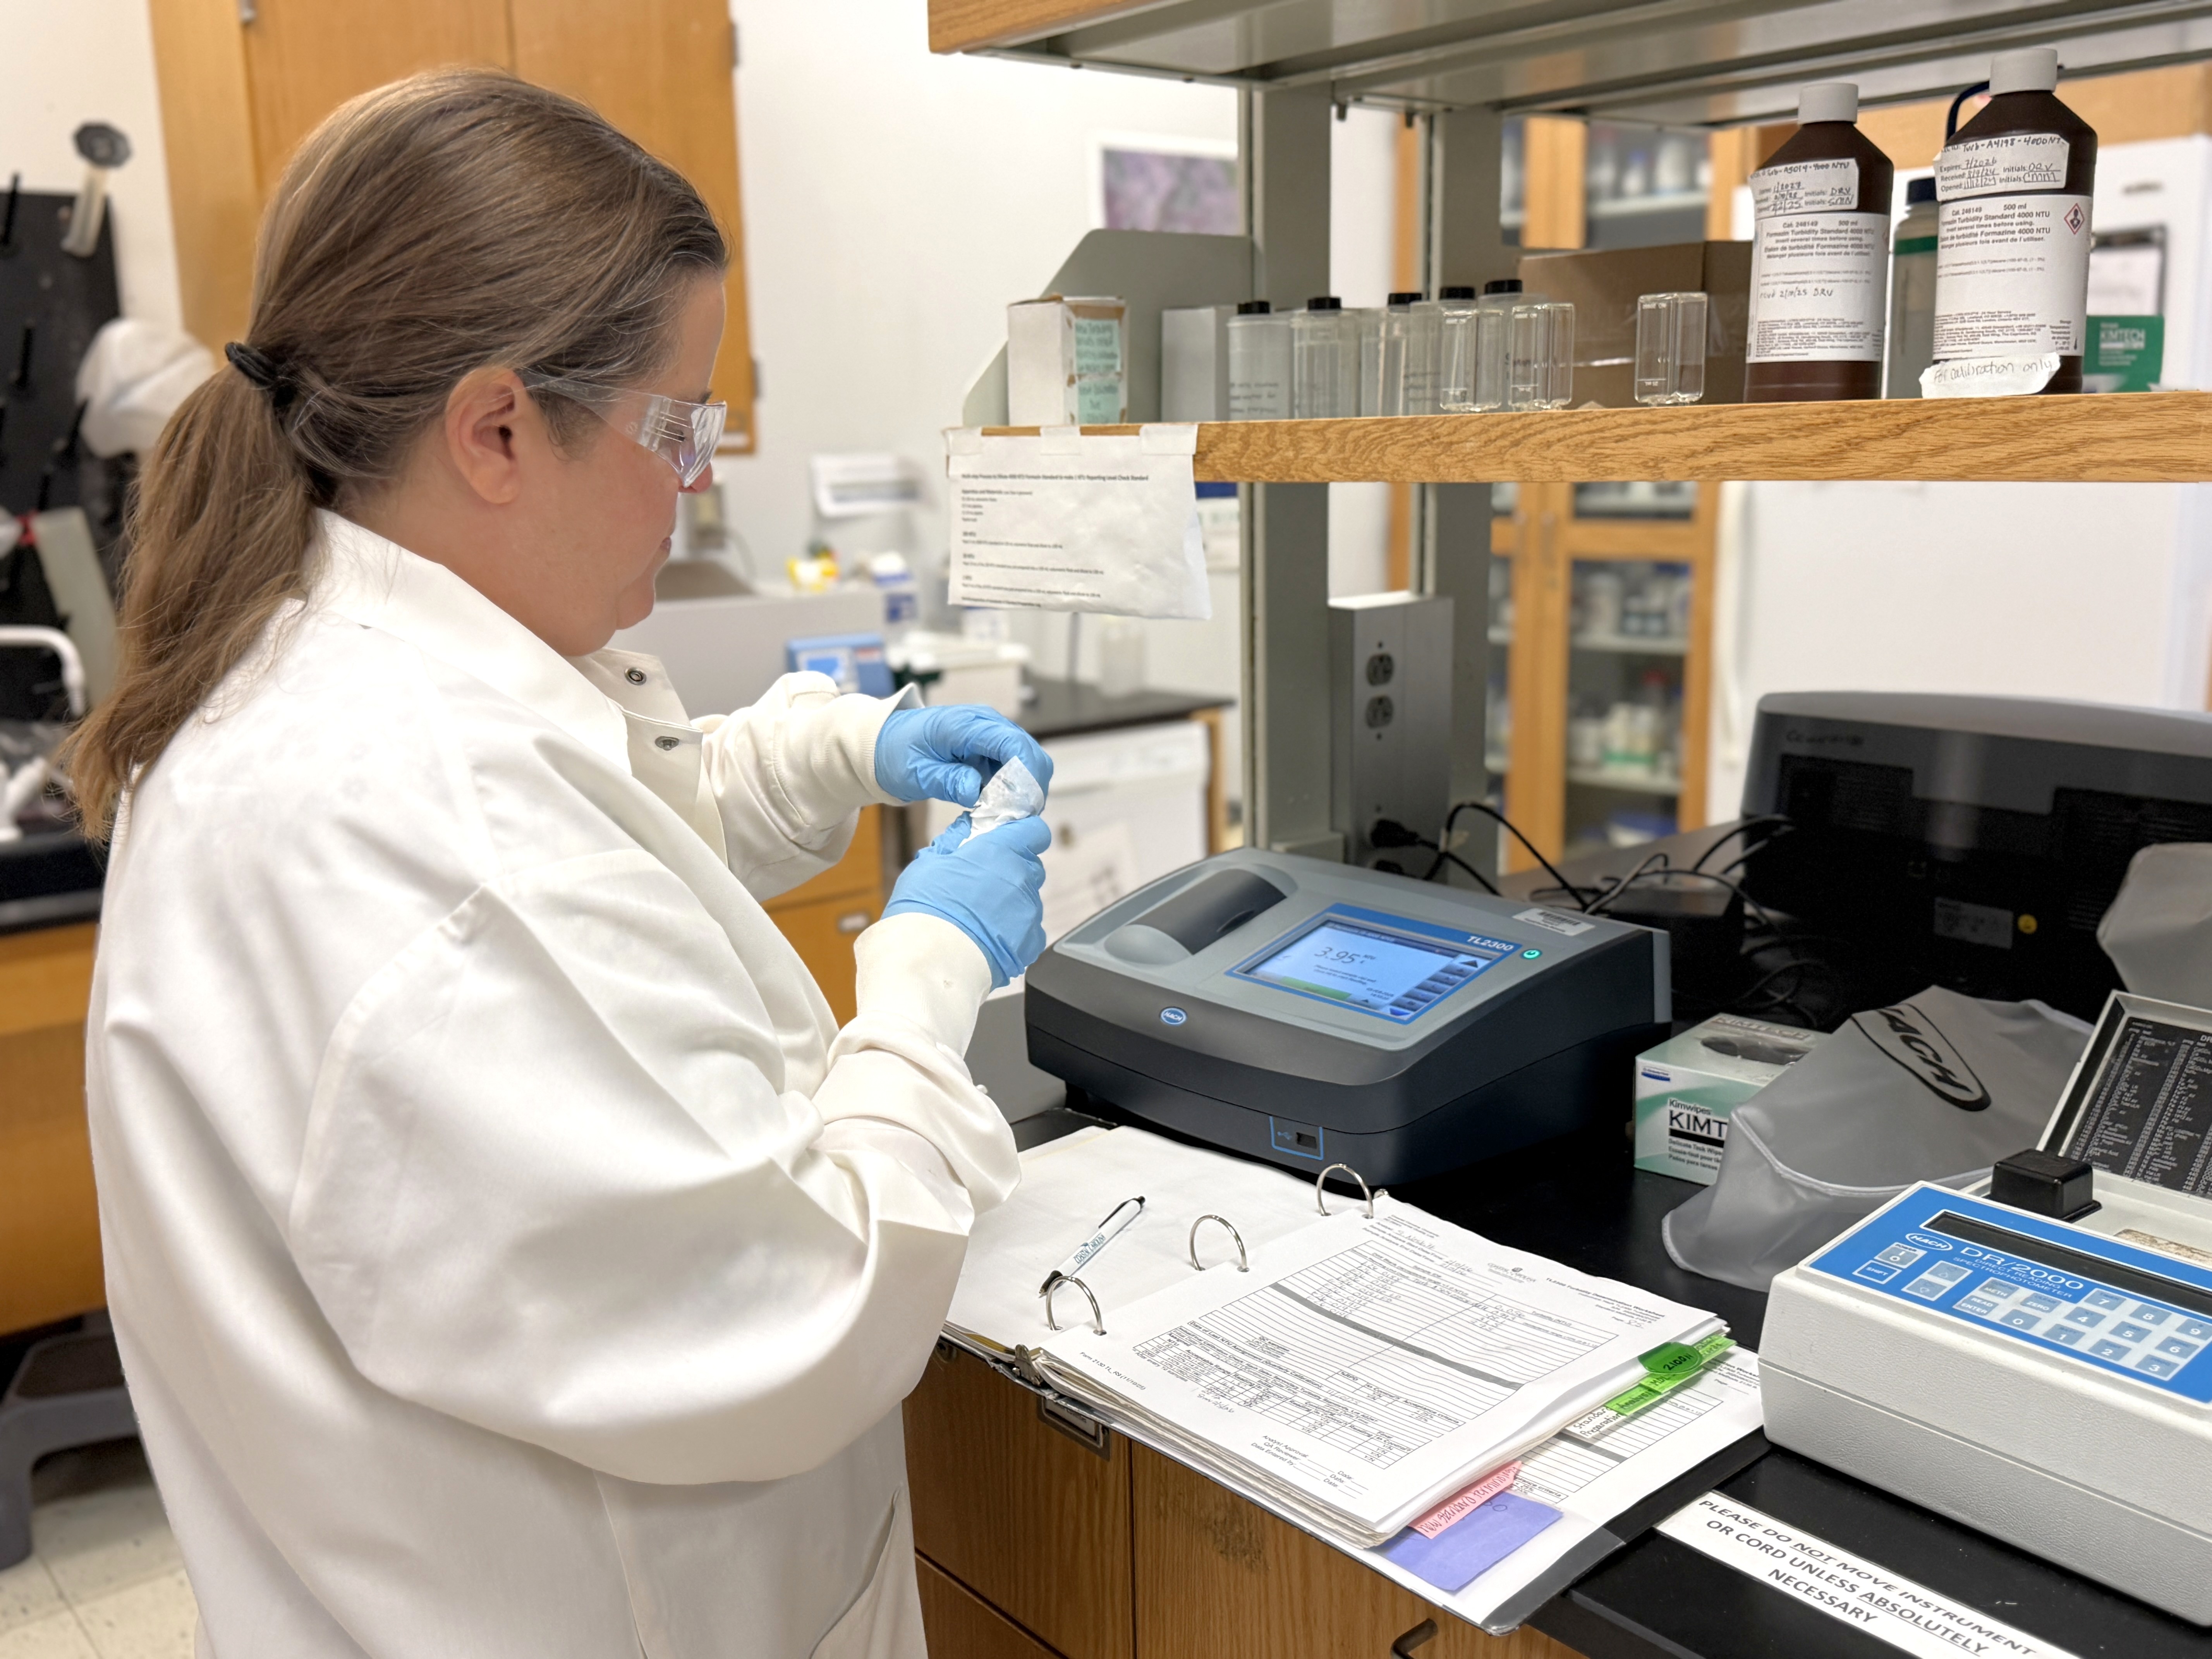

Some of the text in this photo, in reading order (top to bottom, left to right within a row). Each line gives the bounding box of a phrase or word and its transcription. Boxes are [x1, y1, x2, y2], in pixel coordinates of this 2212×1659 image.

[1984, 213, 2015, 221] Standard
[2023, 359, 2053, 373] only
[1467, 935, 1514, 951] TL2300
[1314, 946, 1361, 964] 3.95
[1669, 1098, 1712, 1115] Kimwipes
[1669, 1110, 1728, 1138] KIMT
[1693, 1144, 1706, 1152] Task
[1910, 1235, 1948, 1249] HACH
[1865, 1266, 1889, 1276] SHIFT
[1960, 1247, 2084, 1290] DR/2000
[1975, 1259, 2061, 1289] DIRECT READING
[1953, 1257, 2073, 1298] SPECTROPHOTOMETER
[1984, 1286, 2008, 1297] METH
[1961, 1303, 1988, 1314] ENTER
[1970, 1297, 1994, 1307] READ
[2025, 1301, 2050, 1311] ZERO
[1662, 1353, 1692, 1371] 2100N
[2148, 1364, 2160, 1372] 3
[1250, 1443, 1266, 1451] Data
[1698, 1500, 2038, 1655] PLEASE DO NOT MOVE INSTRUMENT
[1706, 1520, 1990, 1654] OR CORD UNLESS ABSOLUTELY
[1767, 1568, 1878, 1623] NECESSARY
